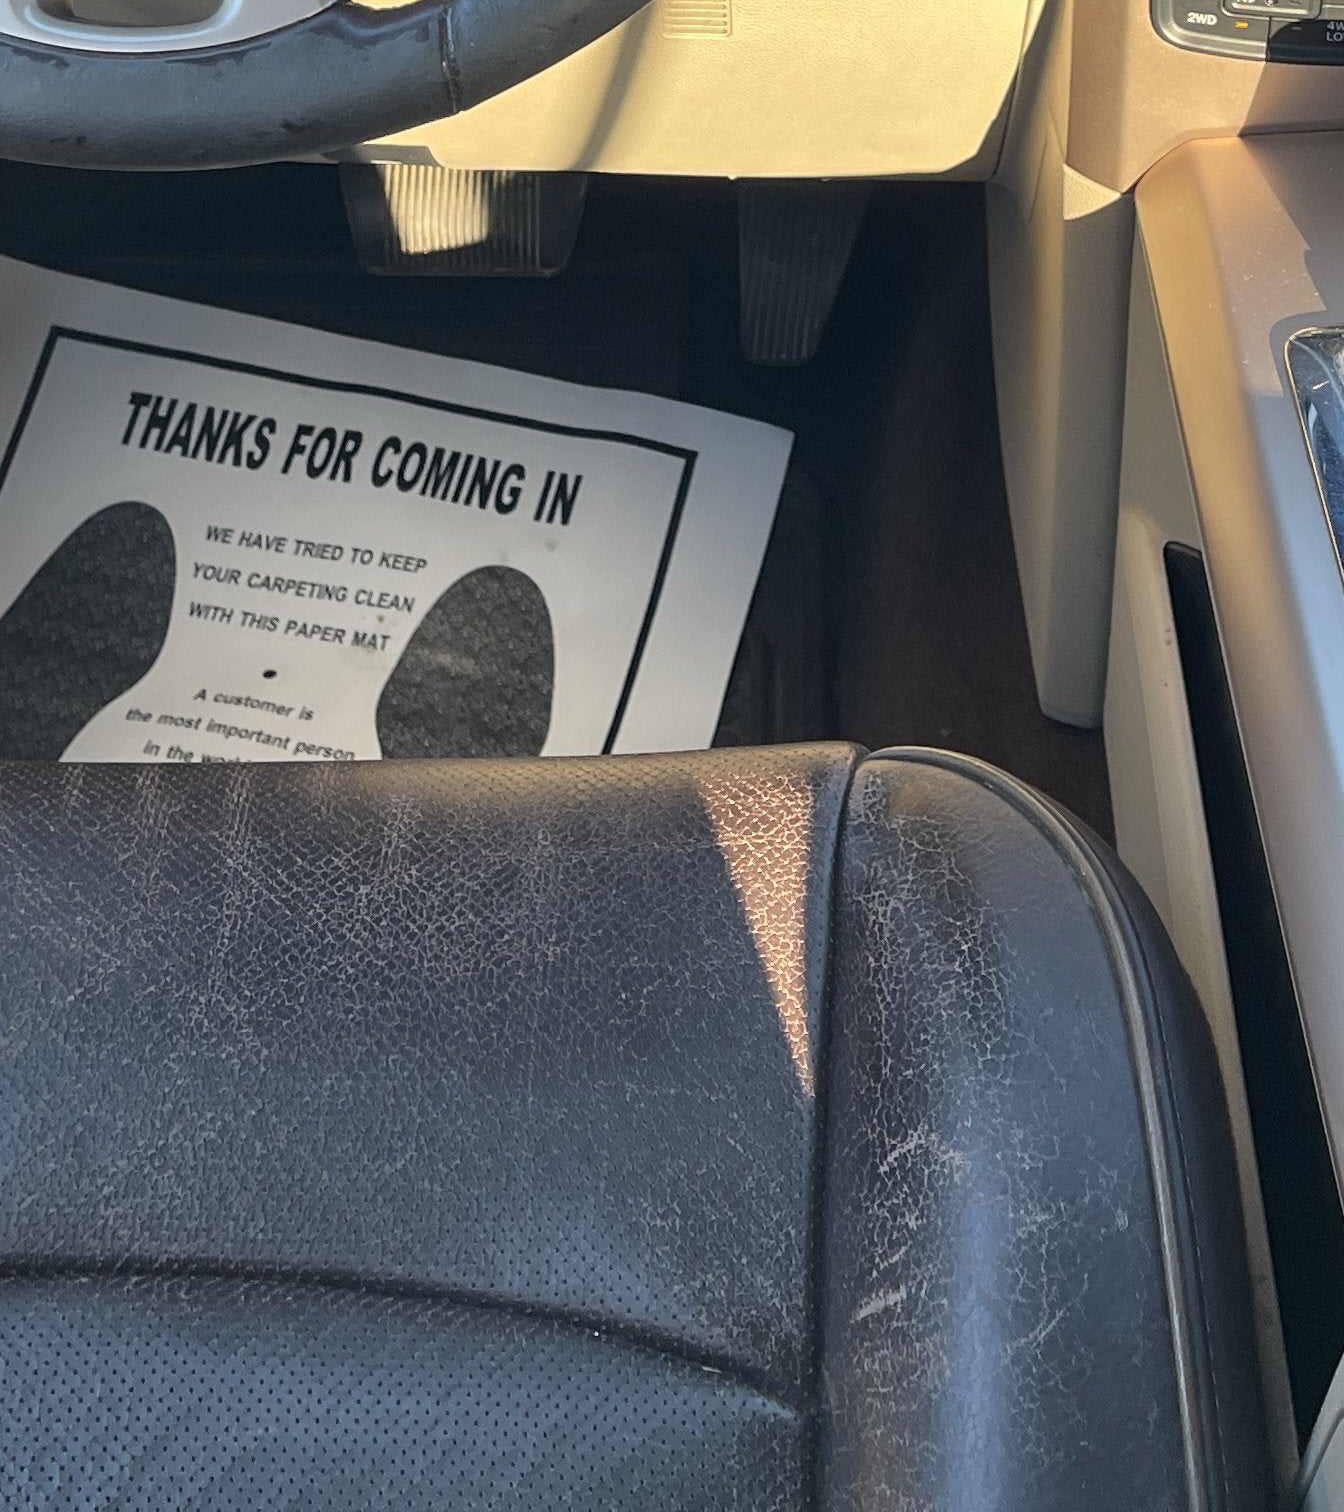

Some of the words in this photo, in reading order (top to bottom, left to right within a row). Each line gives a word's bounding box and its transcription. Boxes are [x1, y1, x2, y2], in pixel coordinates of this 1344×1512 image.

[1186, 12, 1218, 26] 2WD
[120, 390, 277, 472] THANKS
[281, 423, 364, 484] FOR
[370, 435, 527, 516] COMING
[532, 470, 584, 527] IN
[205, 524, 235, 545] WE
[238, 530, 289, 554] HAVE
[293, 539, 345, 562] TRIED
[350, 547, 374, 566] TO
[377, 551, 429, 574] KEEP
[192, 561, 242, 586] YOUR
[246, 572, 348, 604] CARPETING
[354, 588, 417, 614] CLEAN
[189, 601, 235, 625] WITH
[239, 610, 280, 633] THIS
[283, 619, 347, 645] PAPER
[350, 631, 392, 652] MAT
[193, 688, 208, 702] A
[213, 691, 296, 719] customer
[298, 704, 315, 722] is
[125, 708, 154, 724] the
[156, 711, 203, 731] most
[205, 718, 292, 751] important
[292, 740, 356, 762] person
[142, 738, 161, 757] in
[165, 744, 195, 764] the
